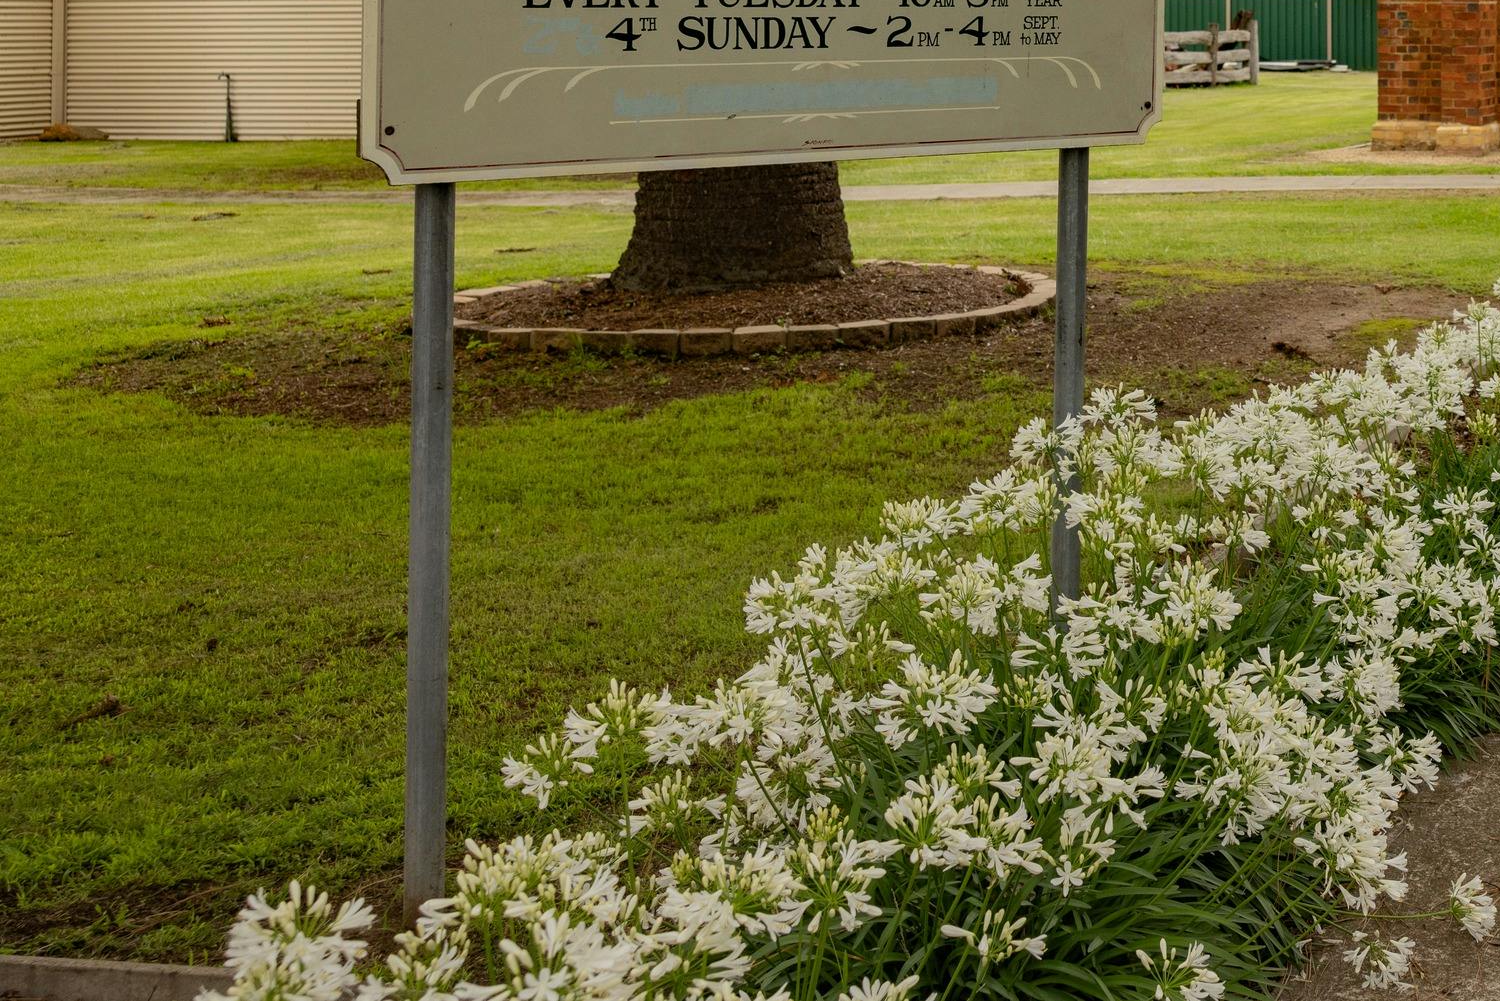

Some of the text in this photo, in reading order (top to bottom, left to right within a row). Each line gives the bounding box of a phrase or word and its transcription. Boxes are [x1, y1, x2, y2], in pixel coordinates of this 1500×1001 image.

[1023, 15, 1061, 31] SEPT.
[676, 15, 836, 52] SUNDAY
[1019, 32, 1062, 46] to MAY
